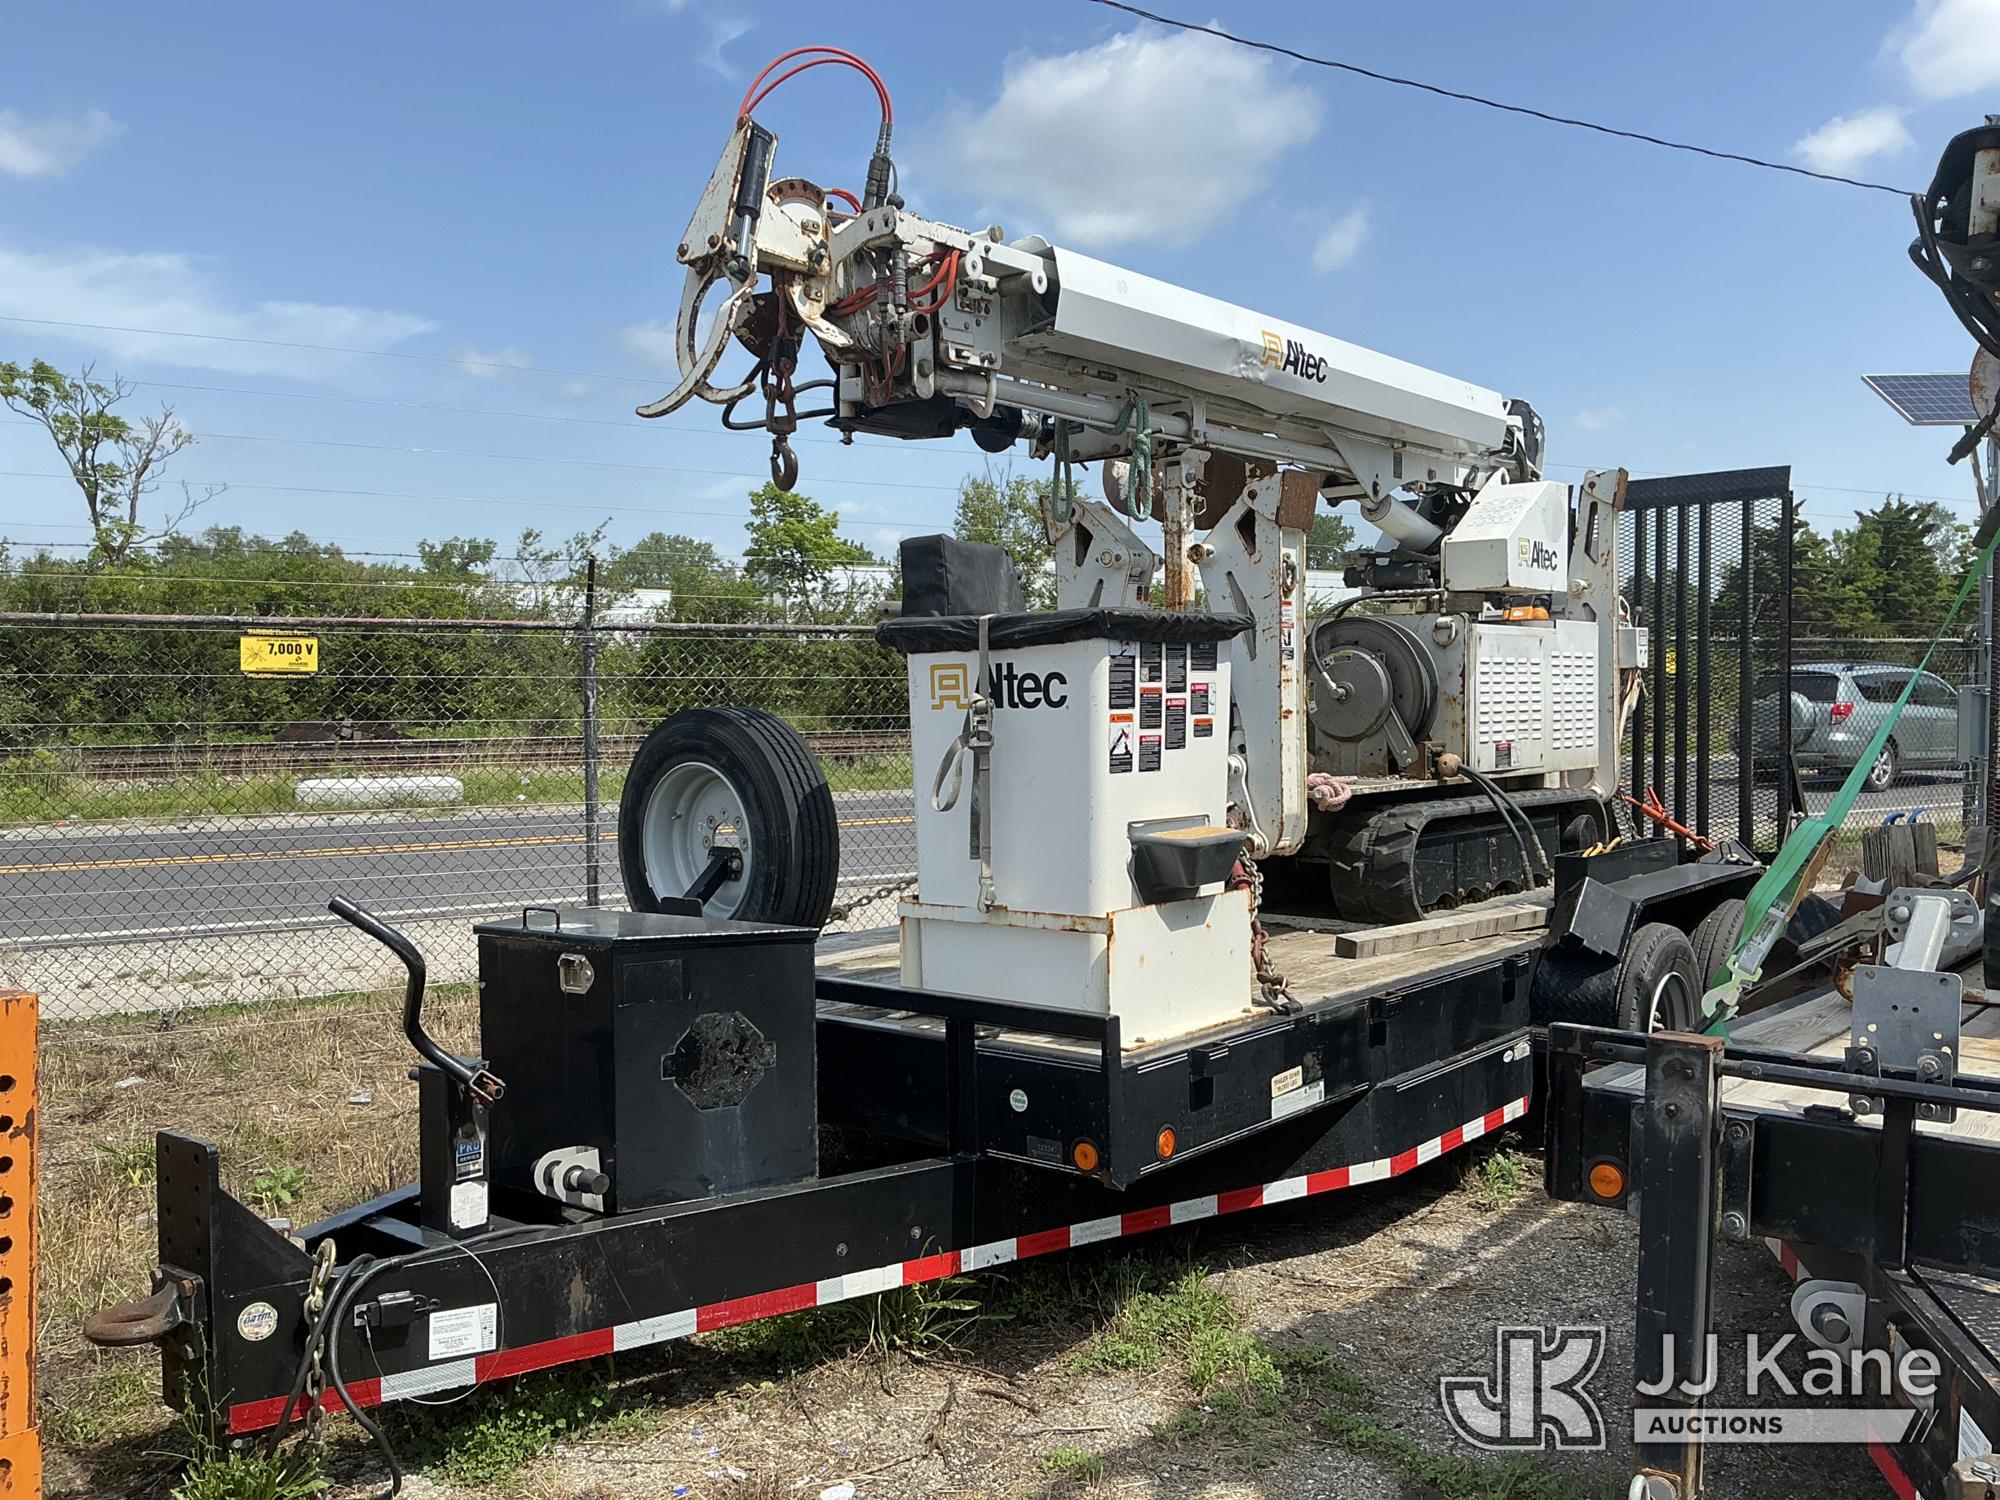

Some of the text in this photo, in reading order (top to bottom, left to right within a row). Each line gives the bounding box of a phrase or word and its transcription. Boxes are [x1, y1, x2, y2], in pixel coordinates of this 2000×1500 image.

[1282, 339, 1328, 383] Altec
[1531, 540, 1557, 571] Altec
[268, 643, 314, 656] 7,000 V
